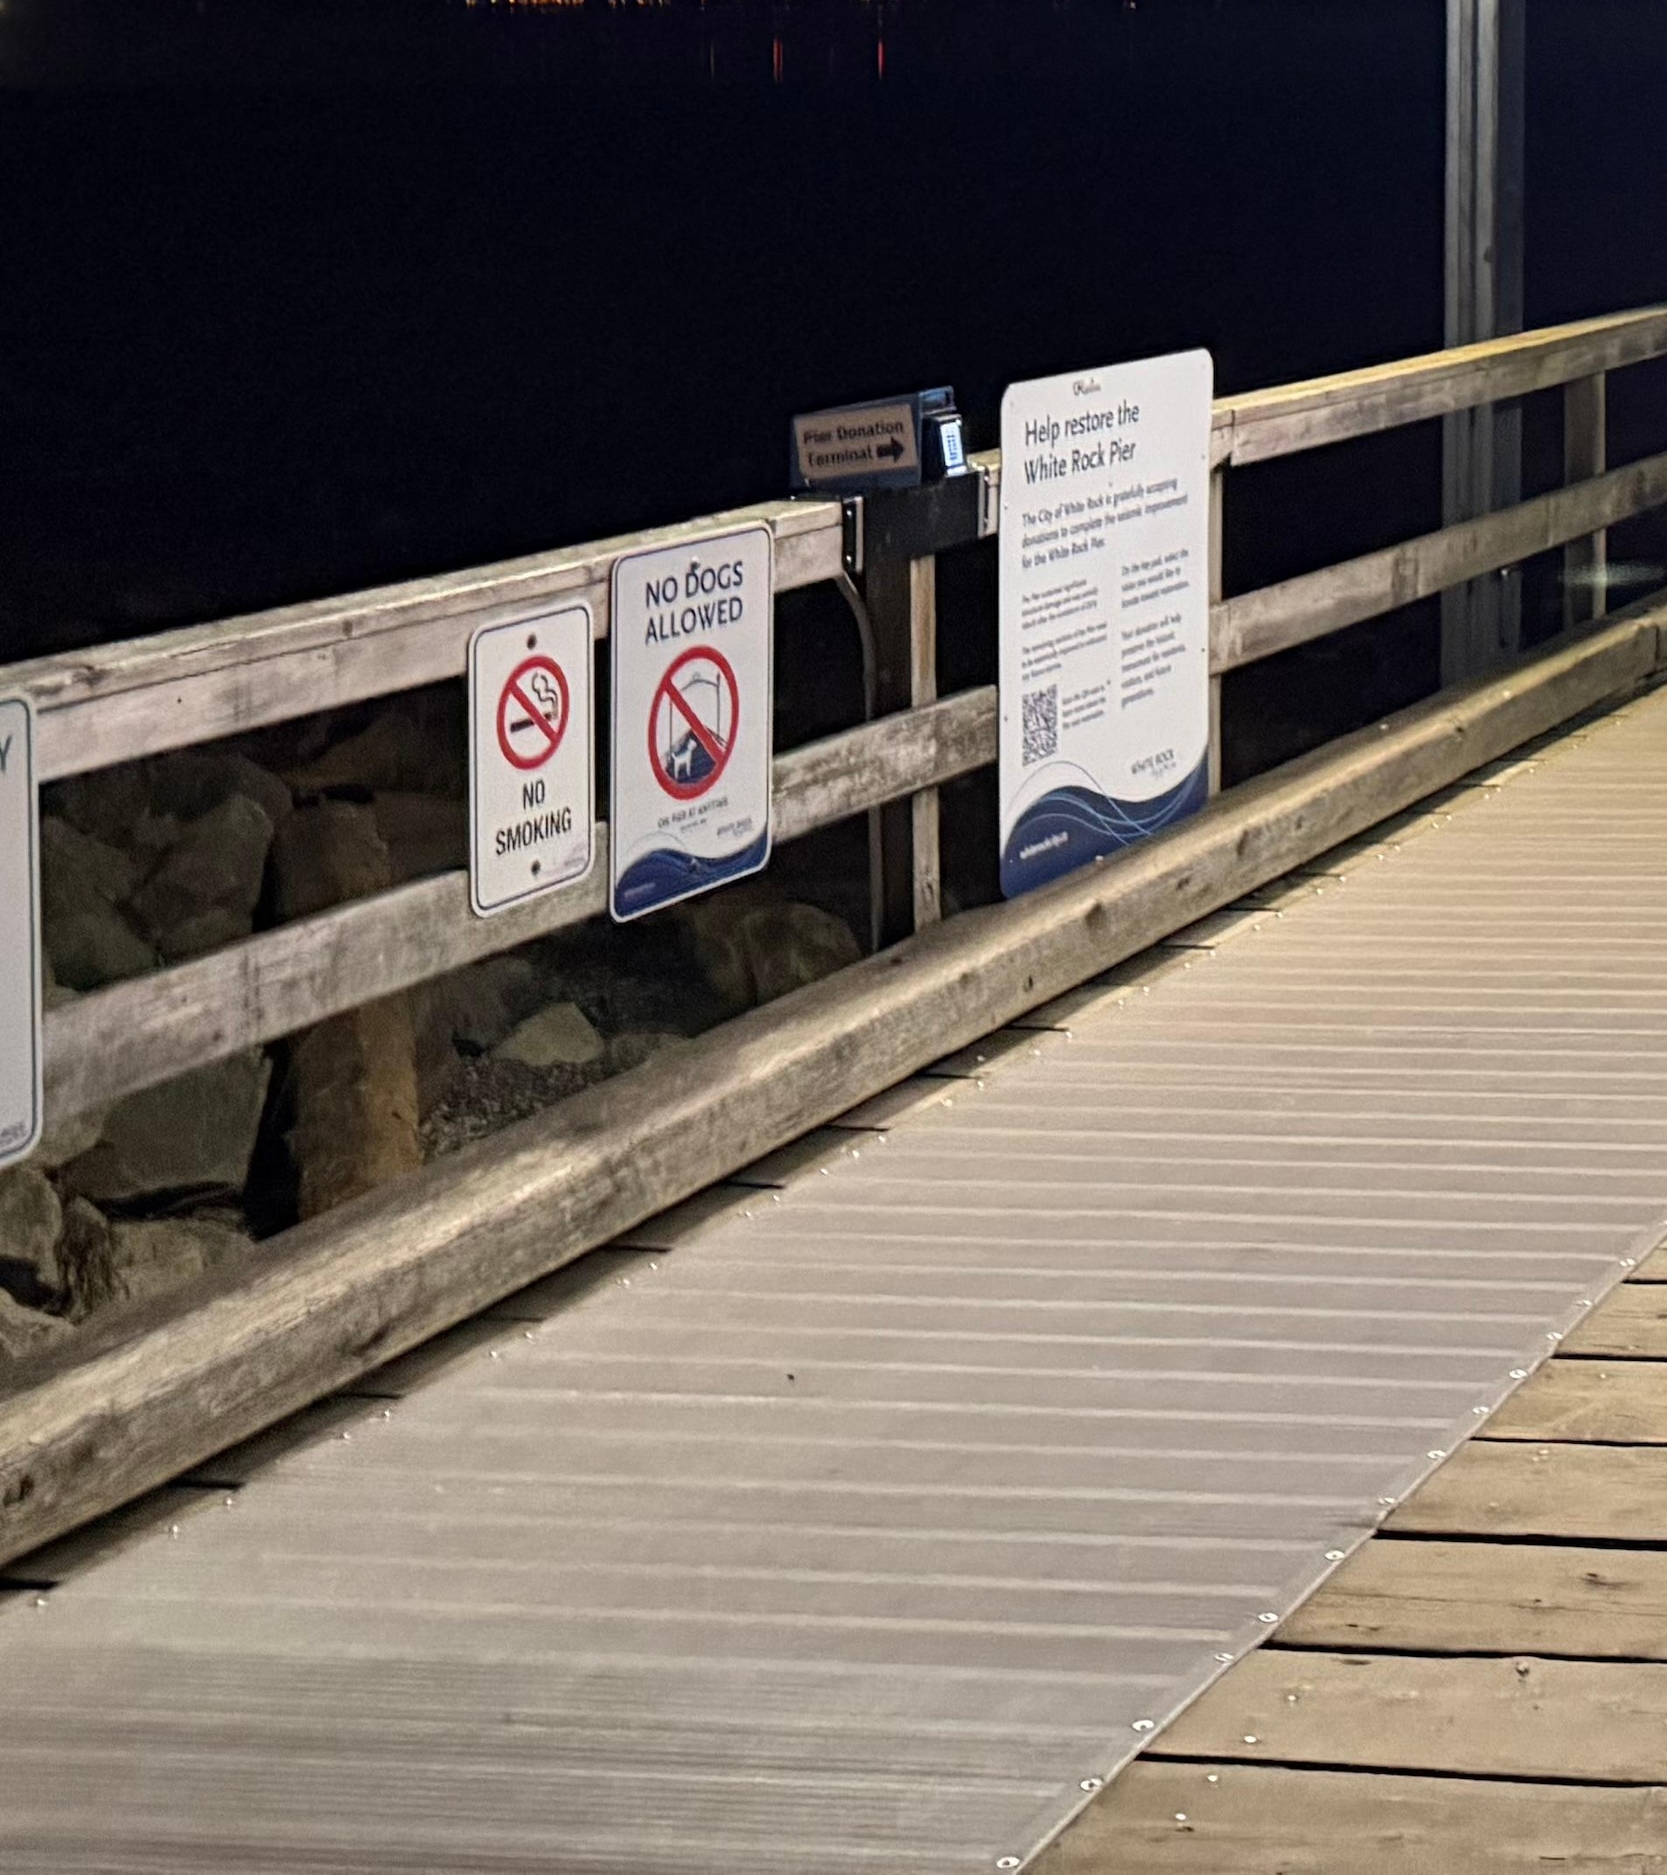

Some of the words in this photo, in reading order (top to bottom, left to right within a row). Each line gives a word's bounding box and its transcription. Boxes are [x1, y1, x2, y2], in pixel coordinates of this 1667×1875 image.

[837, 421, 904, 441] Donation
[1025, 414, 1060, 449] Help
[1064, 409, 1114, 437] restore
[1118, 399, 1140, 426] the
[808, 444, 873, 466] Terminal
[1024, 453, 1067, 485] White
[1071, 442, 1105, 473] Rock
[1110, 437, 1136, 465] Pier
[646, 576, 678, 609] NO
[685, 561, 743, 599] DOGS
[645, 596, 743, 645] ALLOWED
[523, 778, 545, 811] NO
[495, 806, 571, 856] SMOKING
